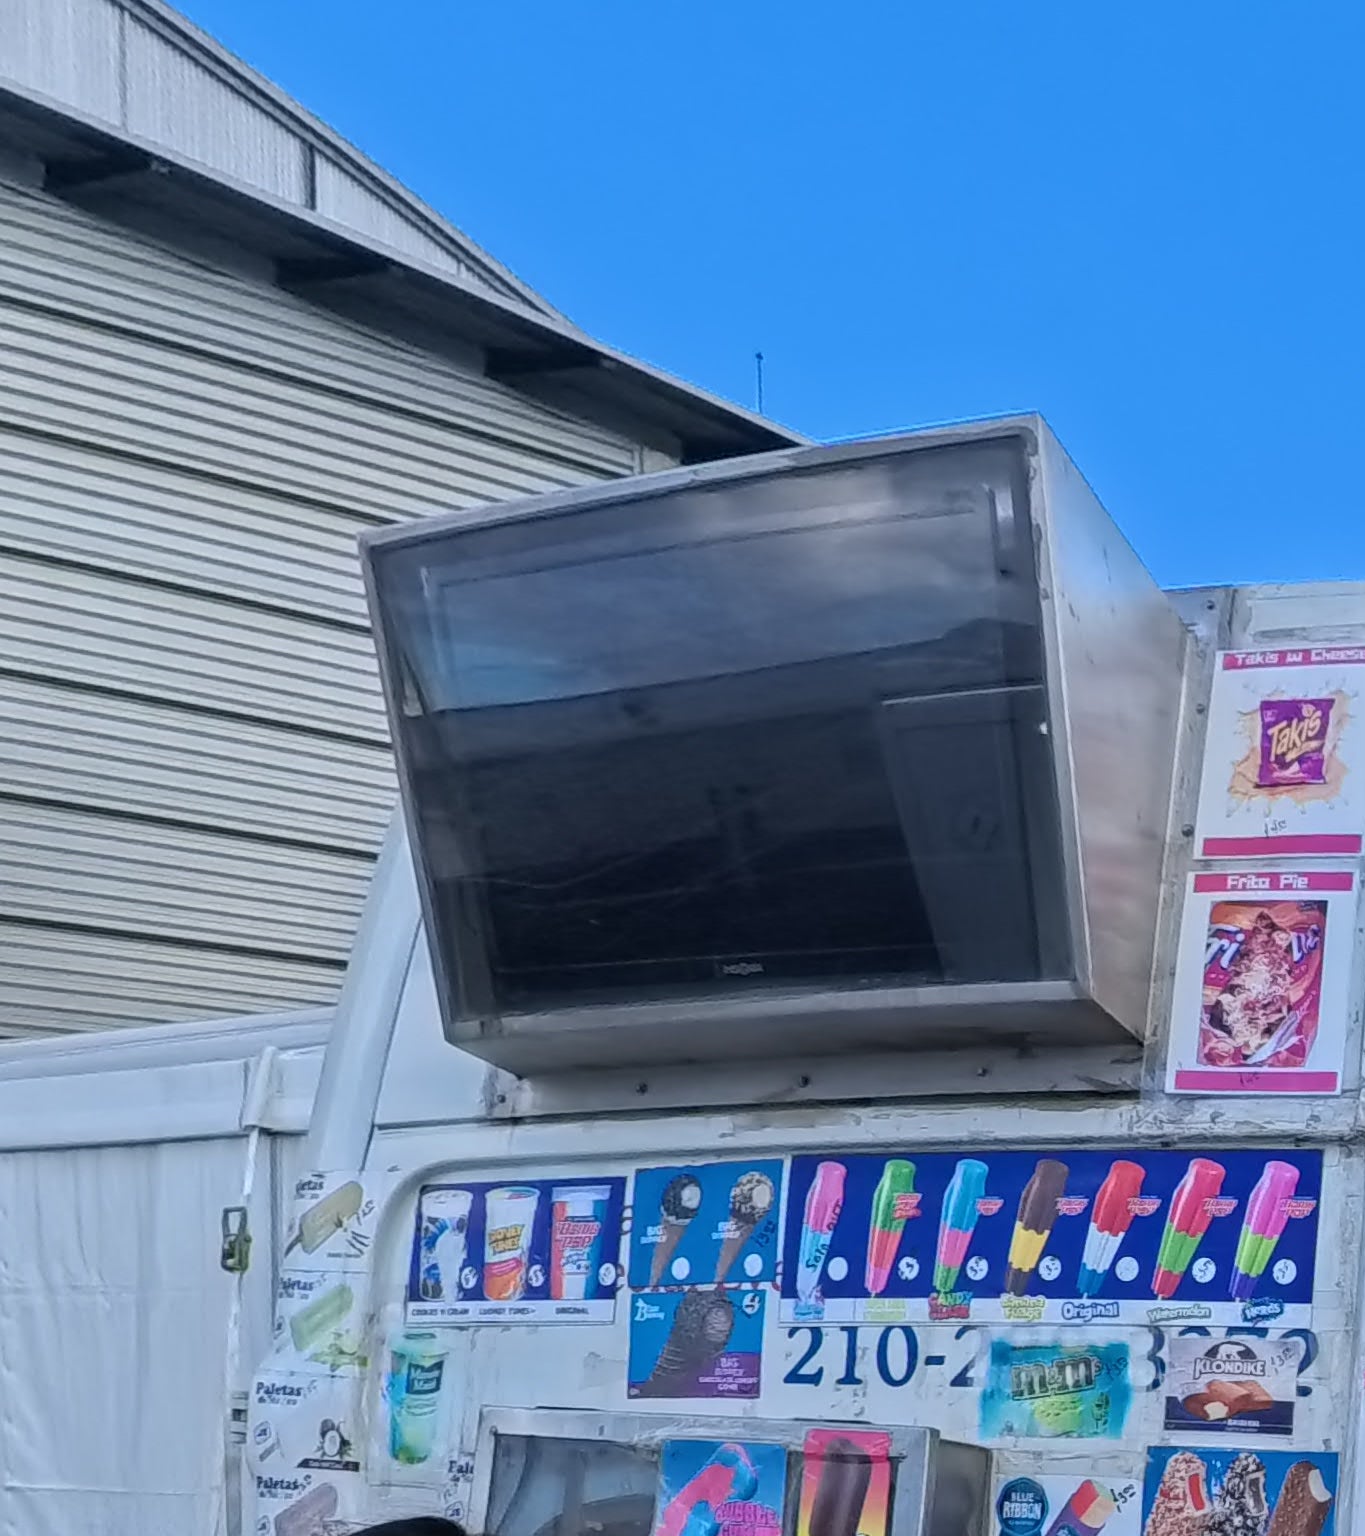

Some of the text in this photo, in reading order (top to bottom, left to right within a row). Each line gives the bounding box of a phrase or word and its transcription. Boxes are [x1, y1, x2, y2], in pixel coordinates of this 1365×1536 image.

[1235, 651, 1279, 666] Takis
[1267, 707, 1322, 758] Takis
[1226, 874, 1309, 889] Frito Pie
[1062, 1302, 1120, 1322] Original
[1193, 1358, 1266, 1380] KLONDIKE
[1003, 1502, 1042, 1519] RIBBON
